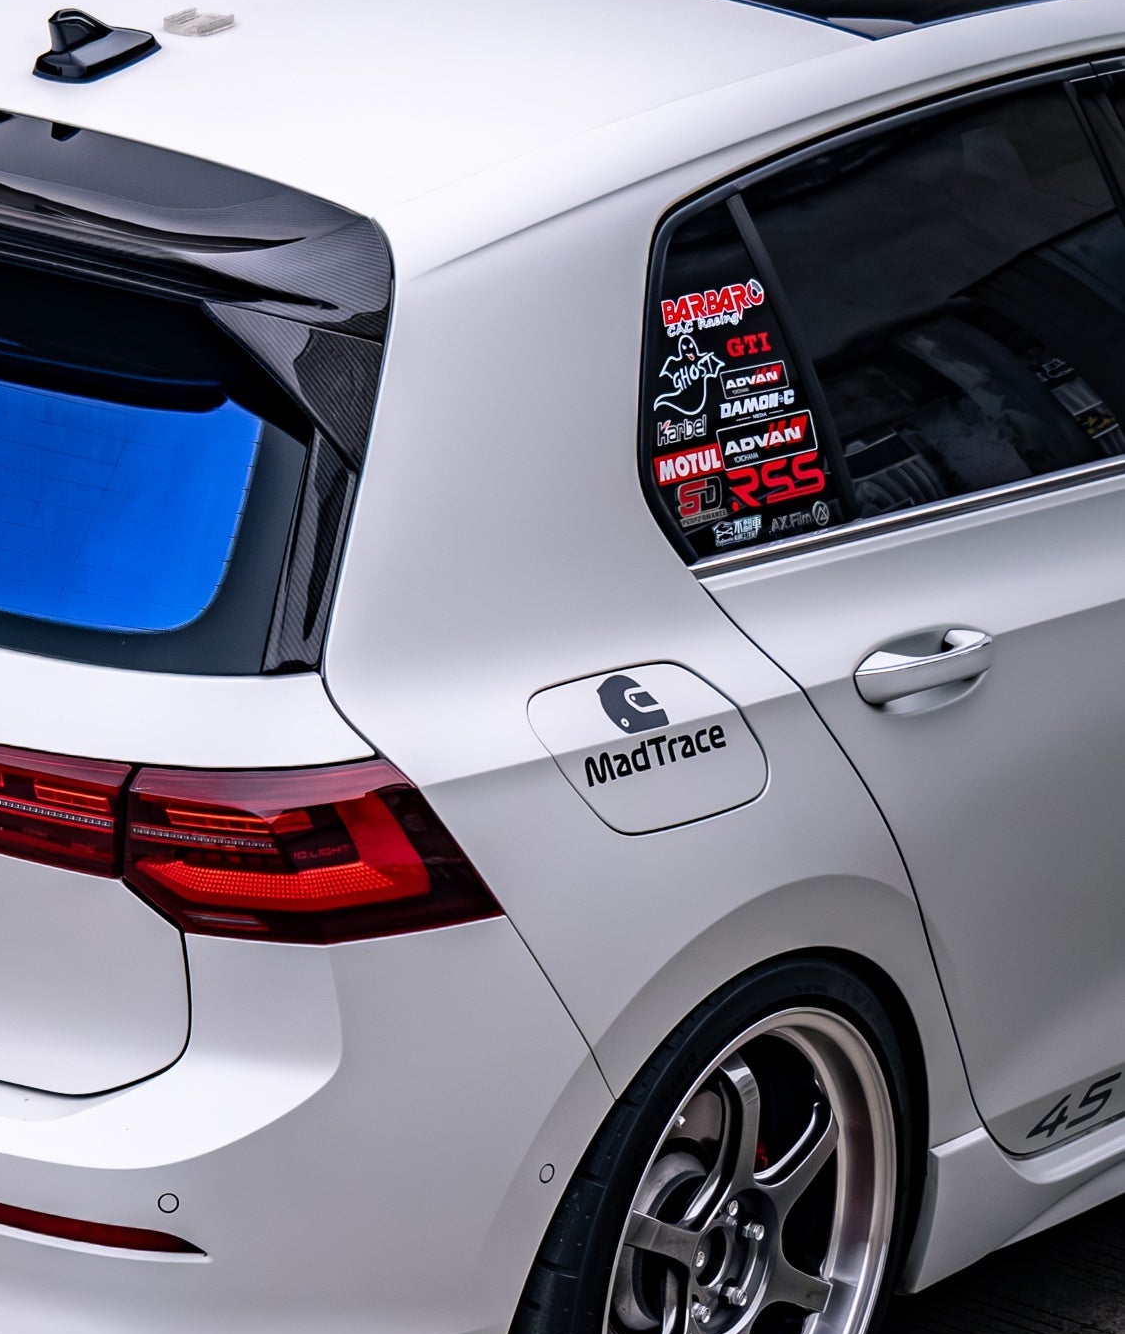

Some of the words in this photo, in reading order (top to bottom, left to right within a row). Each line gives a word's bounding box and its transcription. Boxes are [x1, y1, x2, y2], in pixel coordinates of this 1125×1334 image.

[661, 279, 764, 327] BARBARO
[697, 312, 740, 330] Racing
[726, 332, 772, 357] GTI
[673, 352, 715, 391] GHOST
[726, 370, 779, 389] ADVAN
[725, 426, 802, 456] ADVAN
[659, 448, 722, 483] MOTUL
[726, 451, 825, 512] RSS
[584, 724, 727, 787] MadTrace
